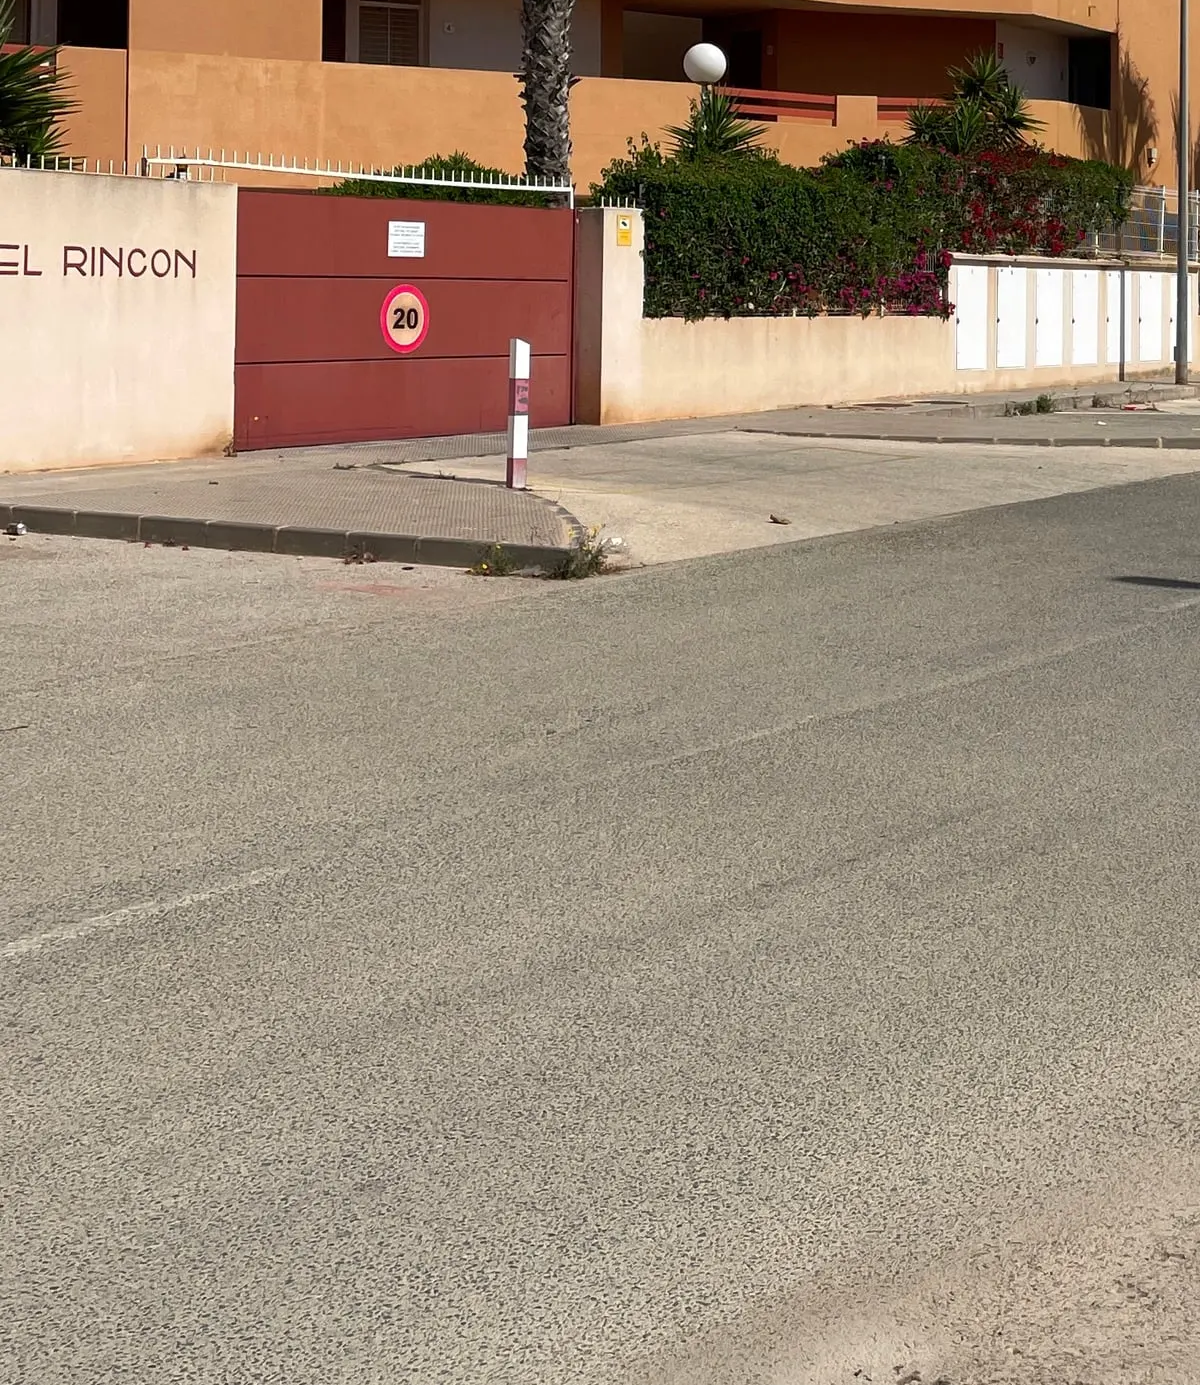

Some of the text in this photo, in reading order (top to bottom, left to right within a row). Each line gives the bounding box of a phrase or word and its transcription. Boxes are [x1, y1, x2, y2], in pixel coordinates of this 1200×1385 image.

[0, 244, 196, 278] EL RINCON
[392, 307, 419, 329] 20
